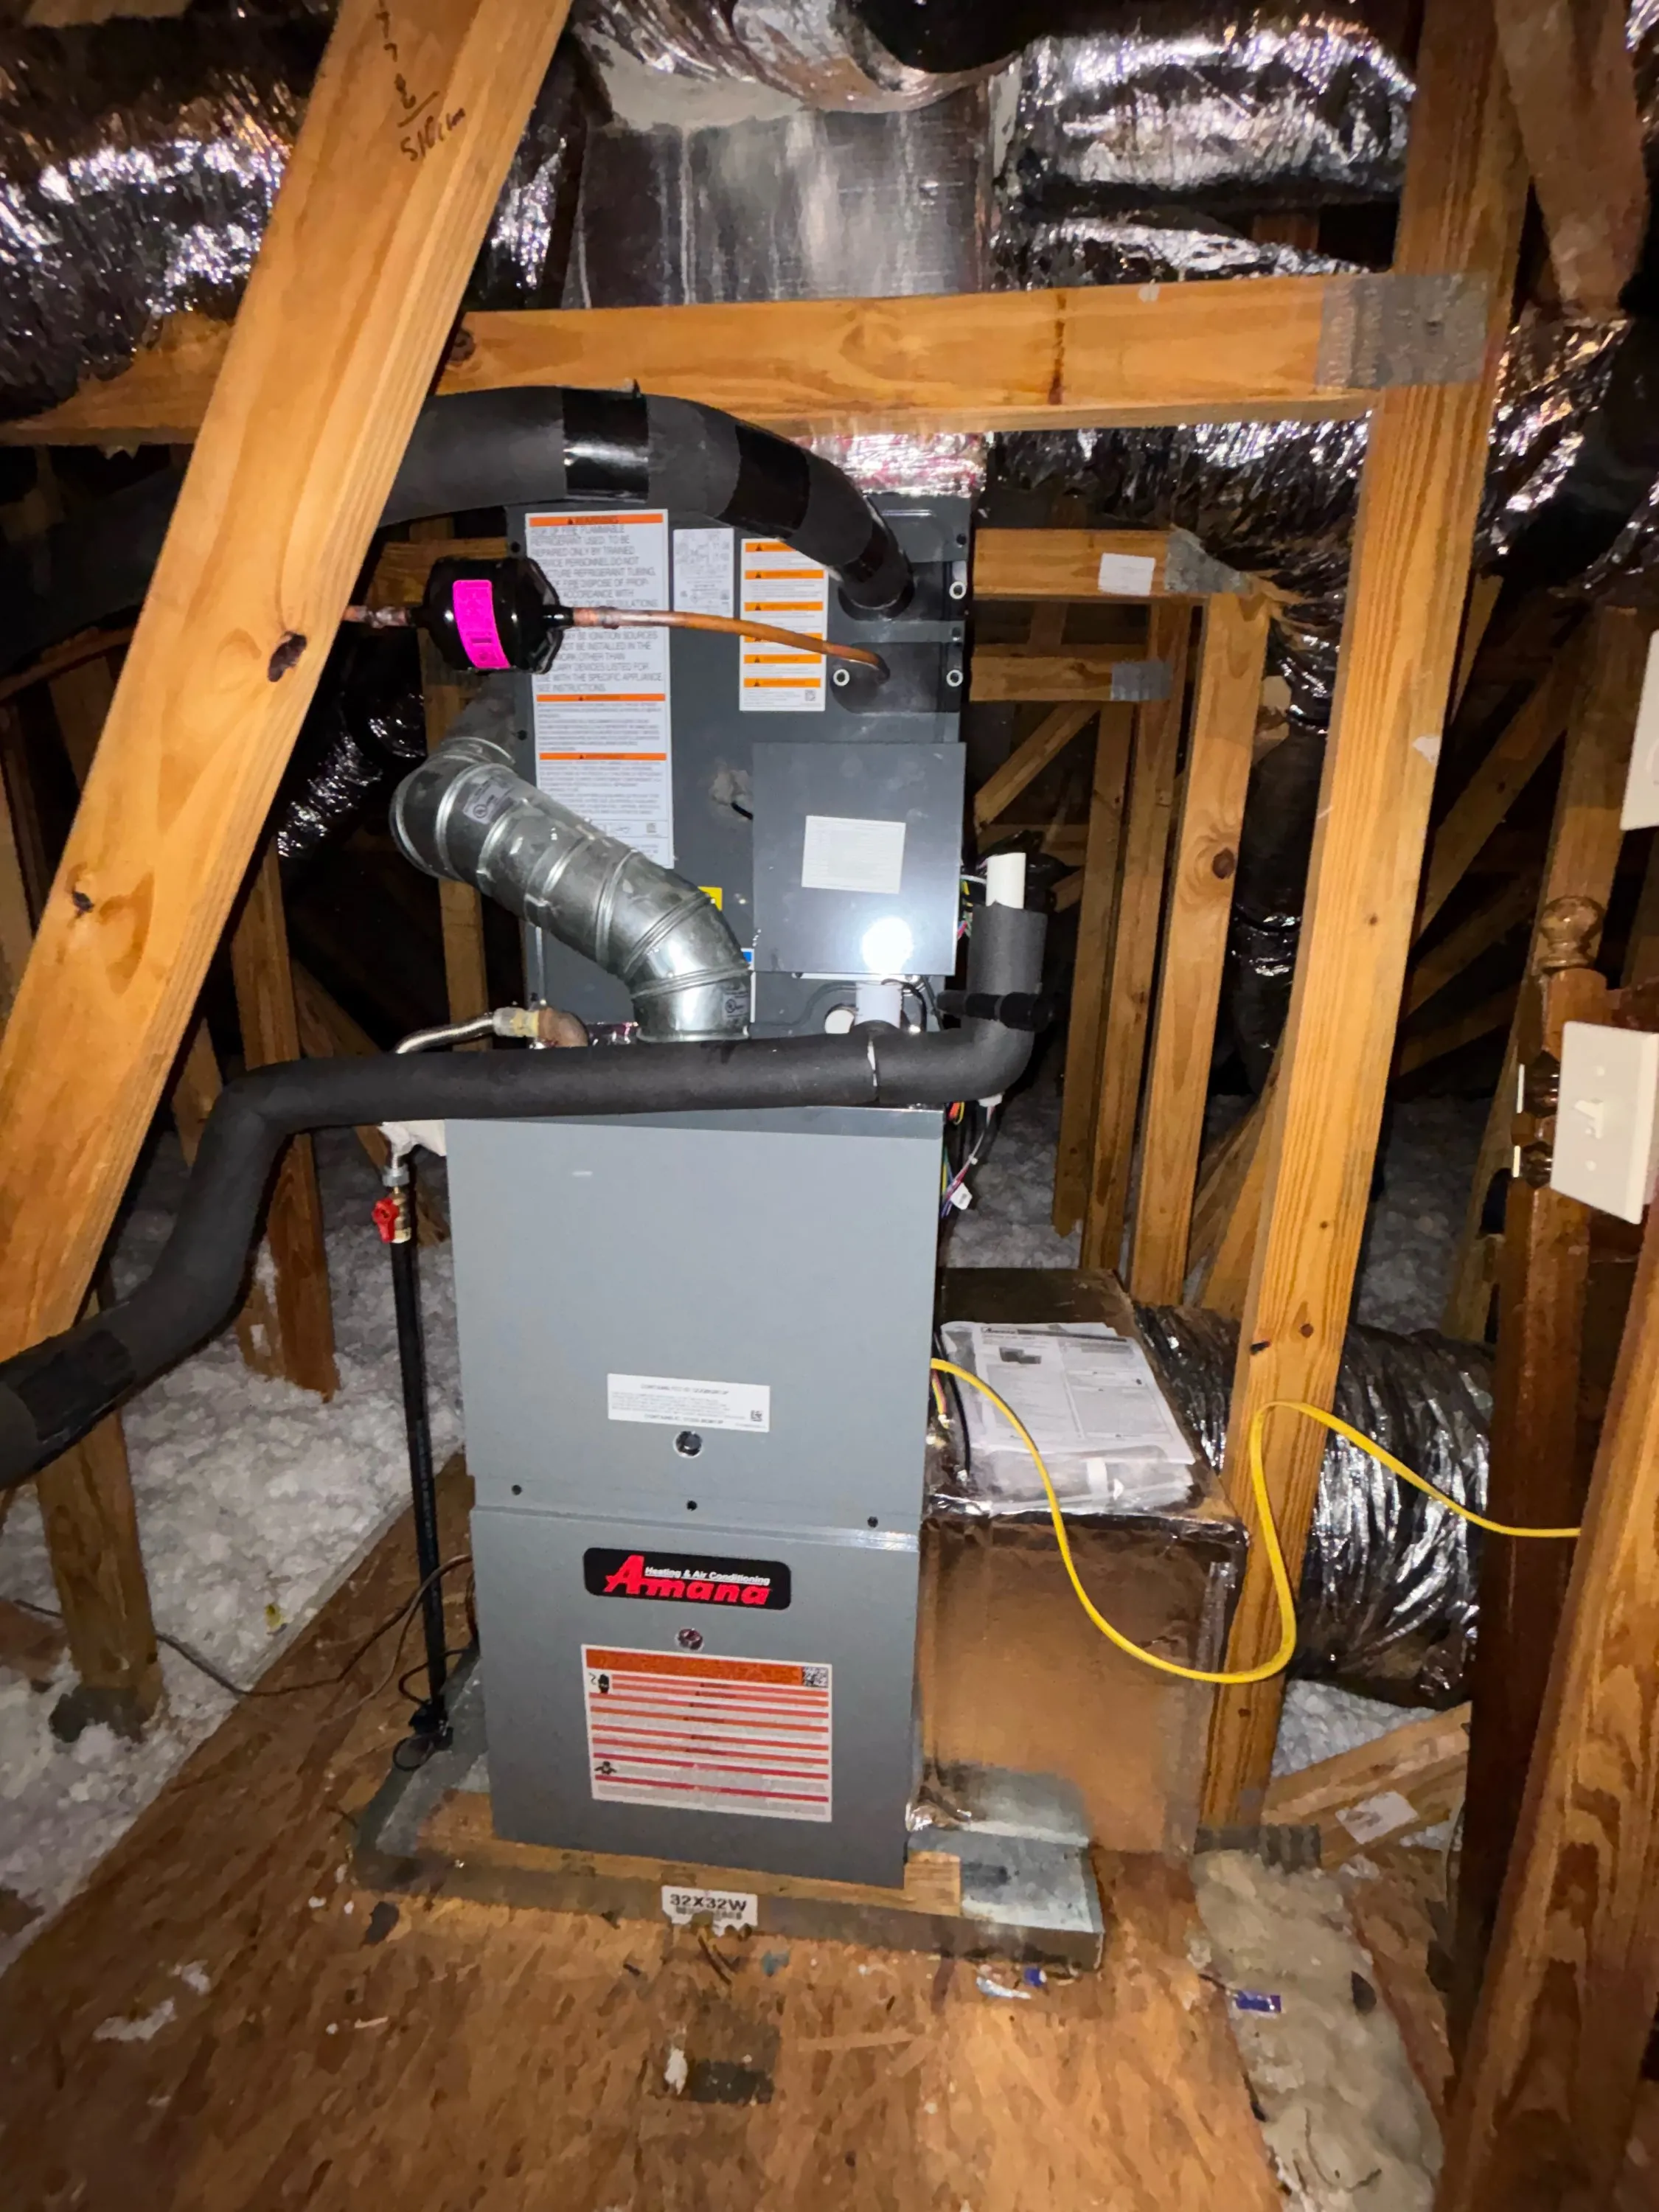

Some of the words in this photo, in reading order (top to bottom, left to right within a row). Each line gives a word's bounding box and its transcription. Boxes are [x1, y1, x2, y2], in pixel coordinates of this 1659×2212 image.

[603, 546, 635, 554] TRAINED
[588, 641, 626, 650] INSTALLED
[603, 1554, 771, 1605] Amana
[644, 1567, 682, 1579] Heating
[684, 1569, 692, 1578] &
[692, 1571, 706, 1579] Air
[709, 1571, 771, 1586] Conditioning
[669, 1893, 747, 1911] 32X32W
